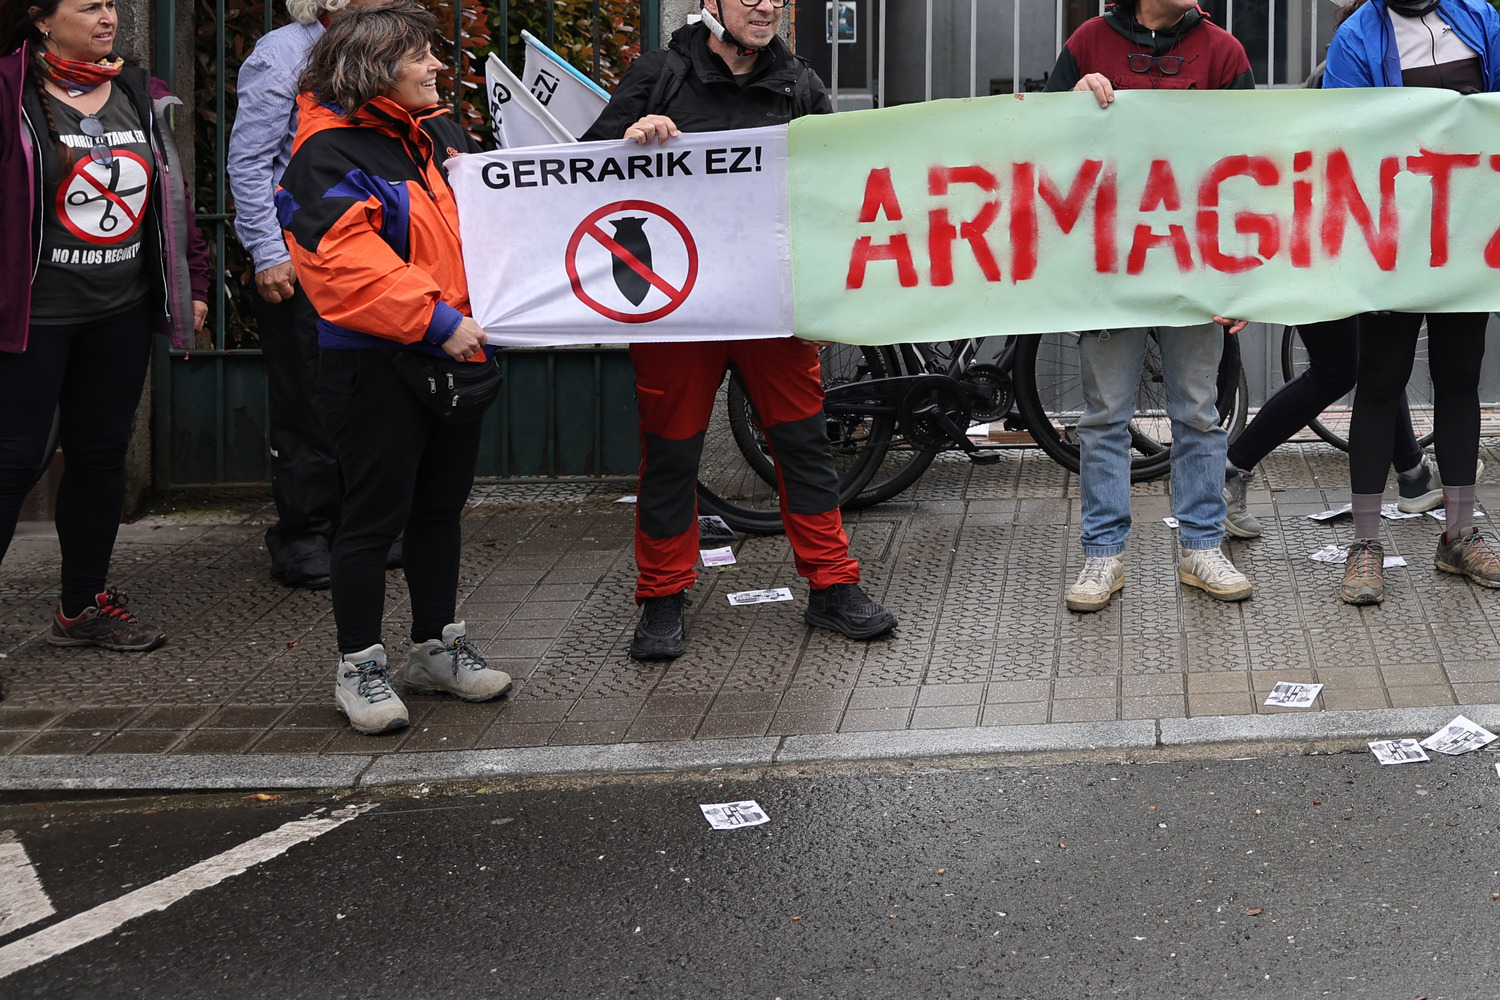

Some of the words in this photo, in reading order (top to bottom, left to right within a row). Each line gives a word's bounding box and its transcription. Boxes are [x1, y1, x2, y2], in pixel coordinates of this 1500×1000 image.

[481, 150, 693, 190] GERRARIK
[705, 146, 763, 175] EZ!
[51, 248, 68, 263] NO
[70, 250, 80, 263] A
[81, 250, 103, 264] LOS
